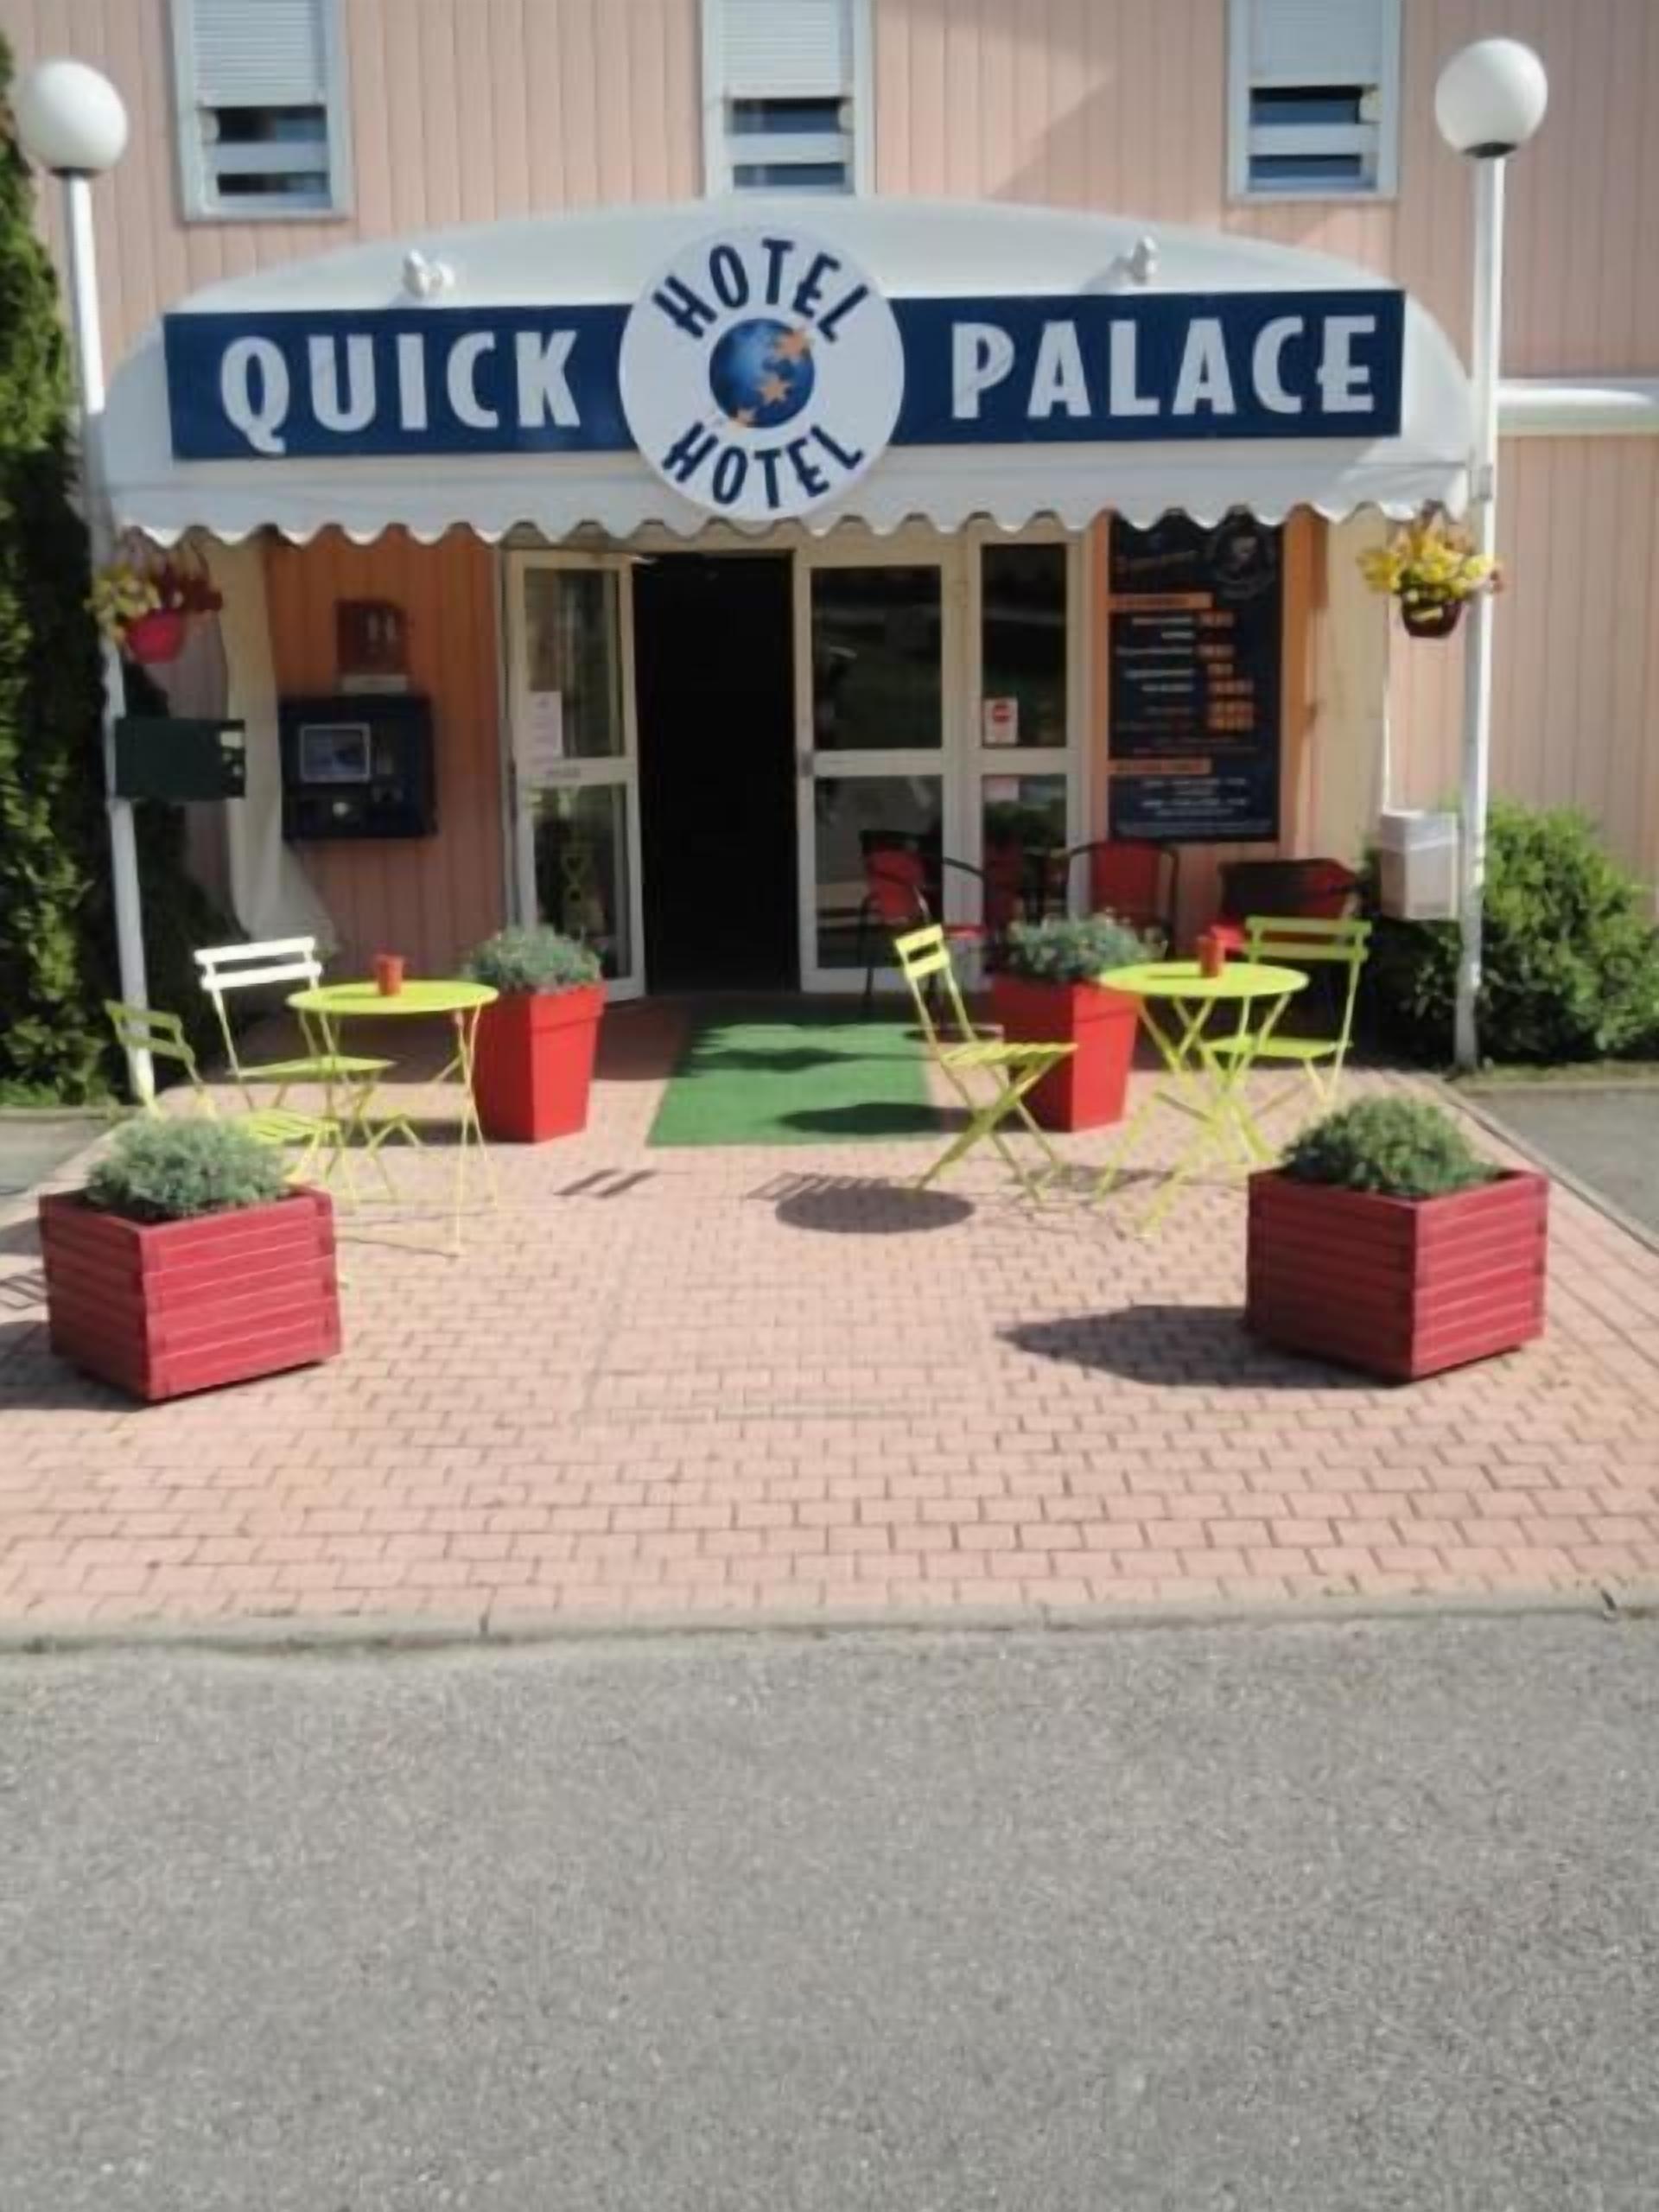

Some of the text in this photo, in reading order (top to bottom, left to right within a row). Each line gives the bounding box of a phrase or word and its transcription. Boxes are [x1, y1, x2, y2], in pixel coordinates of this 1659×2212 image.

[651, 236, 869, 344] HOTEL
[221, 330, 580, 454] QUICK
[952, 315, 1376, 420] PALACE
[661, 421, 865, 510] HOTEL
